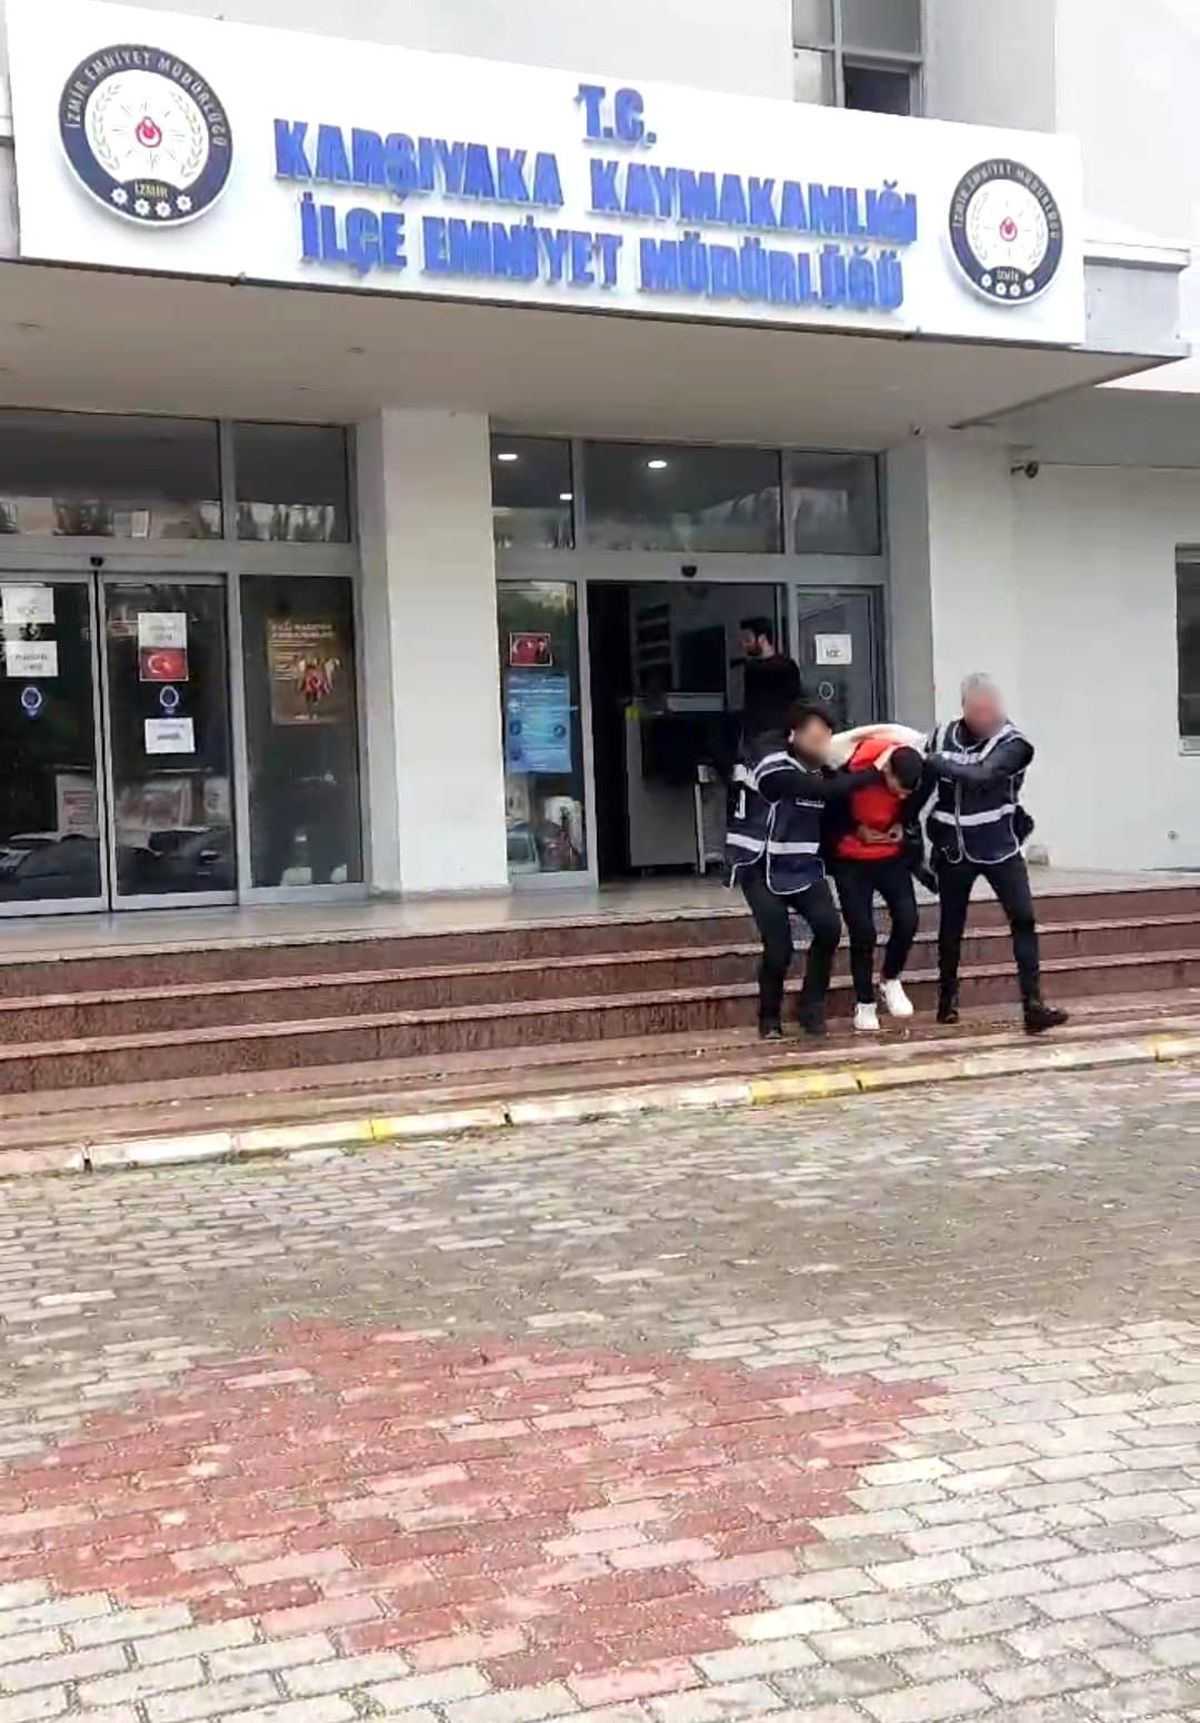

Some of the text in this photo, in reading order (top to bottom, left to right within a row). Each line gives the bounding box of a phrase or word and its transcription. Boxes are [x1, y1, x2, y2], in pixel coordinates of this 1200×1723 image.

[64, 80, 89, 129] İZMİR
[84, 50, 150, 81] EMNİYET
[578, 83, 657, 144] T.C.
[134, 181, 169, 199] İZMİR
[273, 118, 918, 243] KARŞIYAKA KAYMAKAMLIĞI
[300, 191, 904, 310] İLÇE EMNİYET MÜDÜRLÜĞÜ
